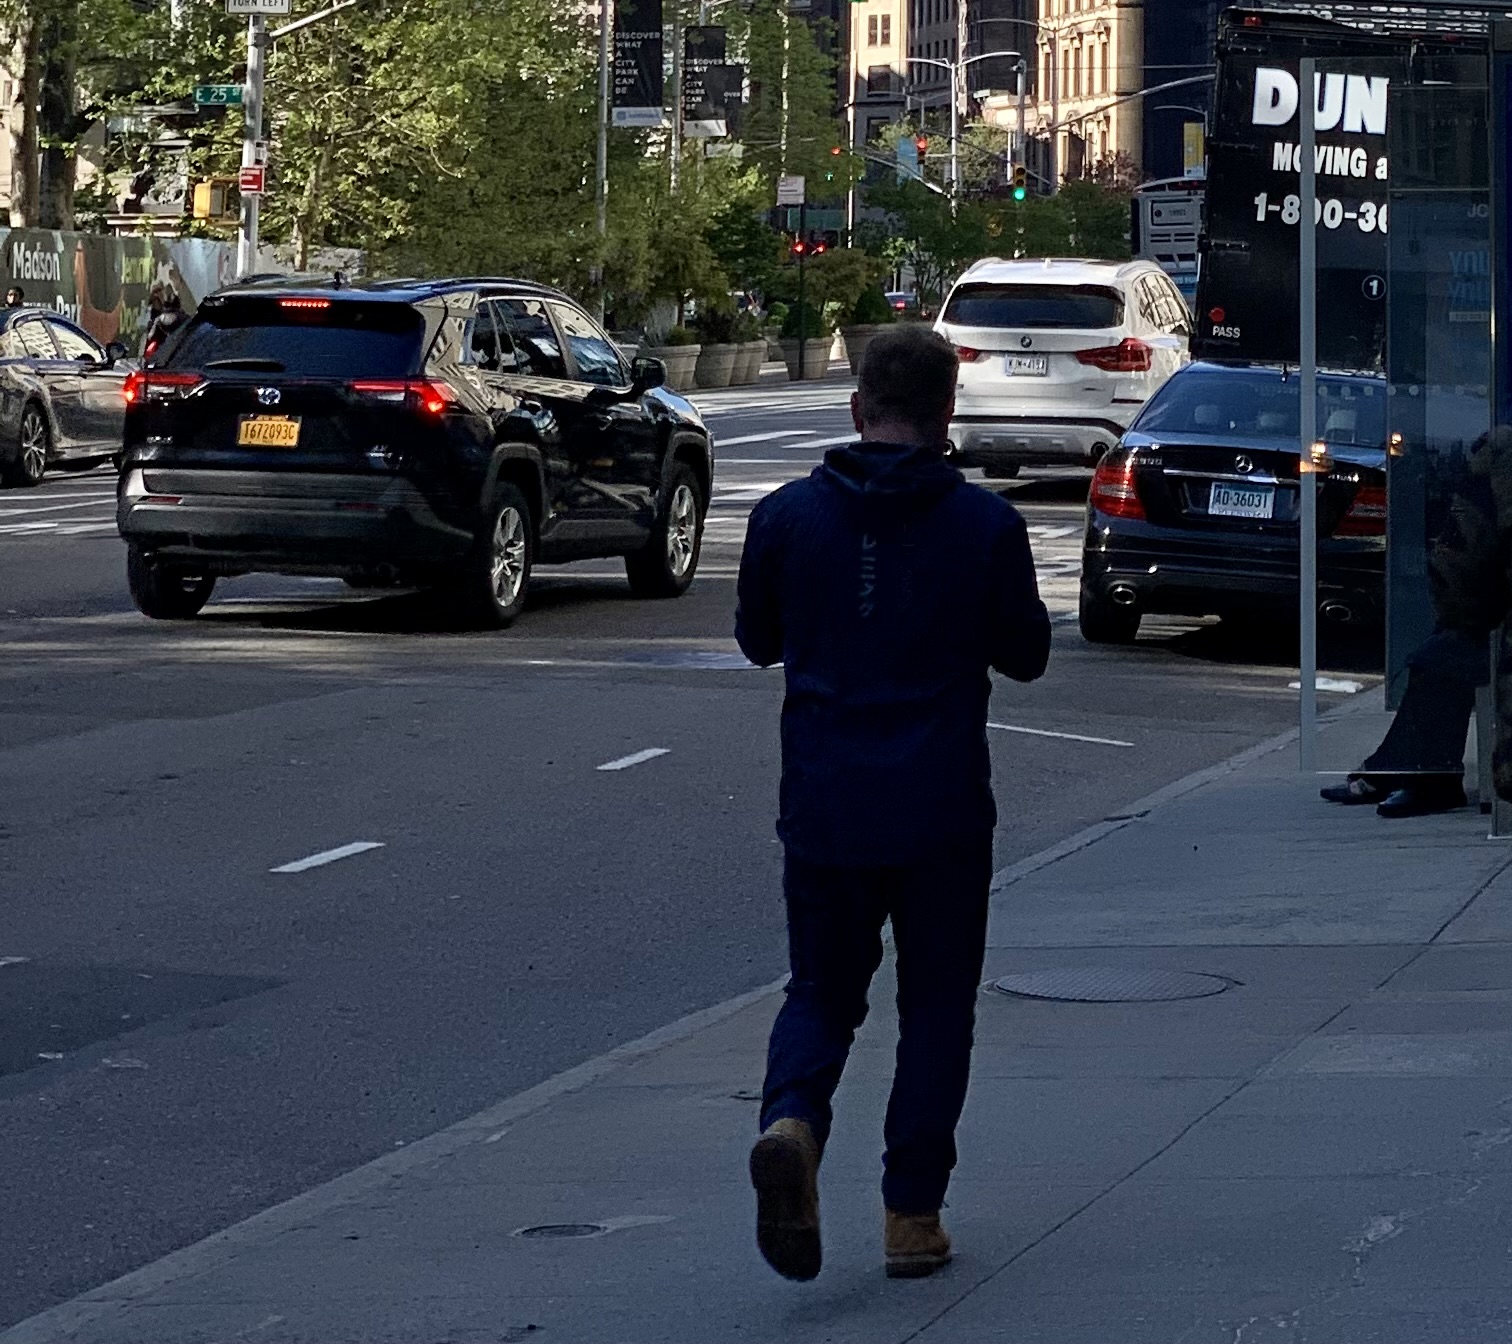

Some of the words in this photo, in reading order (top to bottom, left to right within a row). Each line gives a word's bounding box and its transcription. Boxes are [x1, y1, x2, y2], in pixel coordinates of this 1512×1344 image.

[615, 32, 661, 40] DISCOVER
[615, 41, 643, 49] WHAT
[615, 59, 636, 68] CITY
[615, 78, 635, 86] CAN
[196, 87, 204, 102] E
[210, 87, 227, 102] 25
[1252, 67, 1390, 135] DUN
[1368, 279, 1379, 296] 1
[1212, 325, 1241, 339] PASS
[243, 422, 296, 441] T672093C
